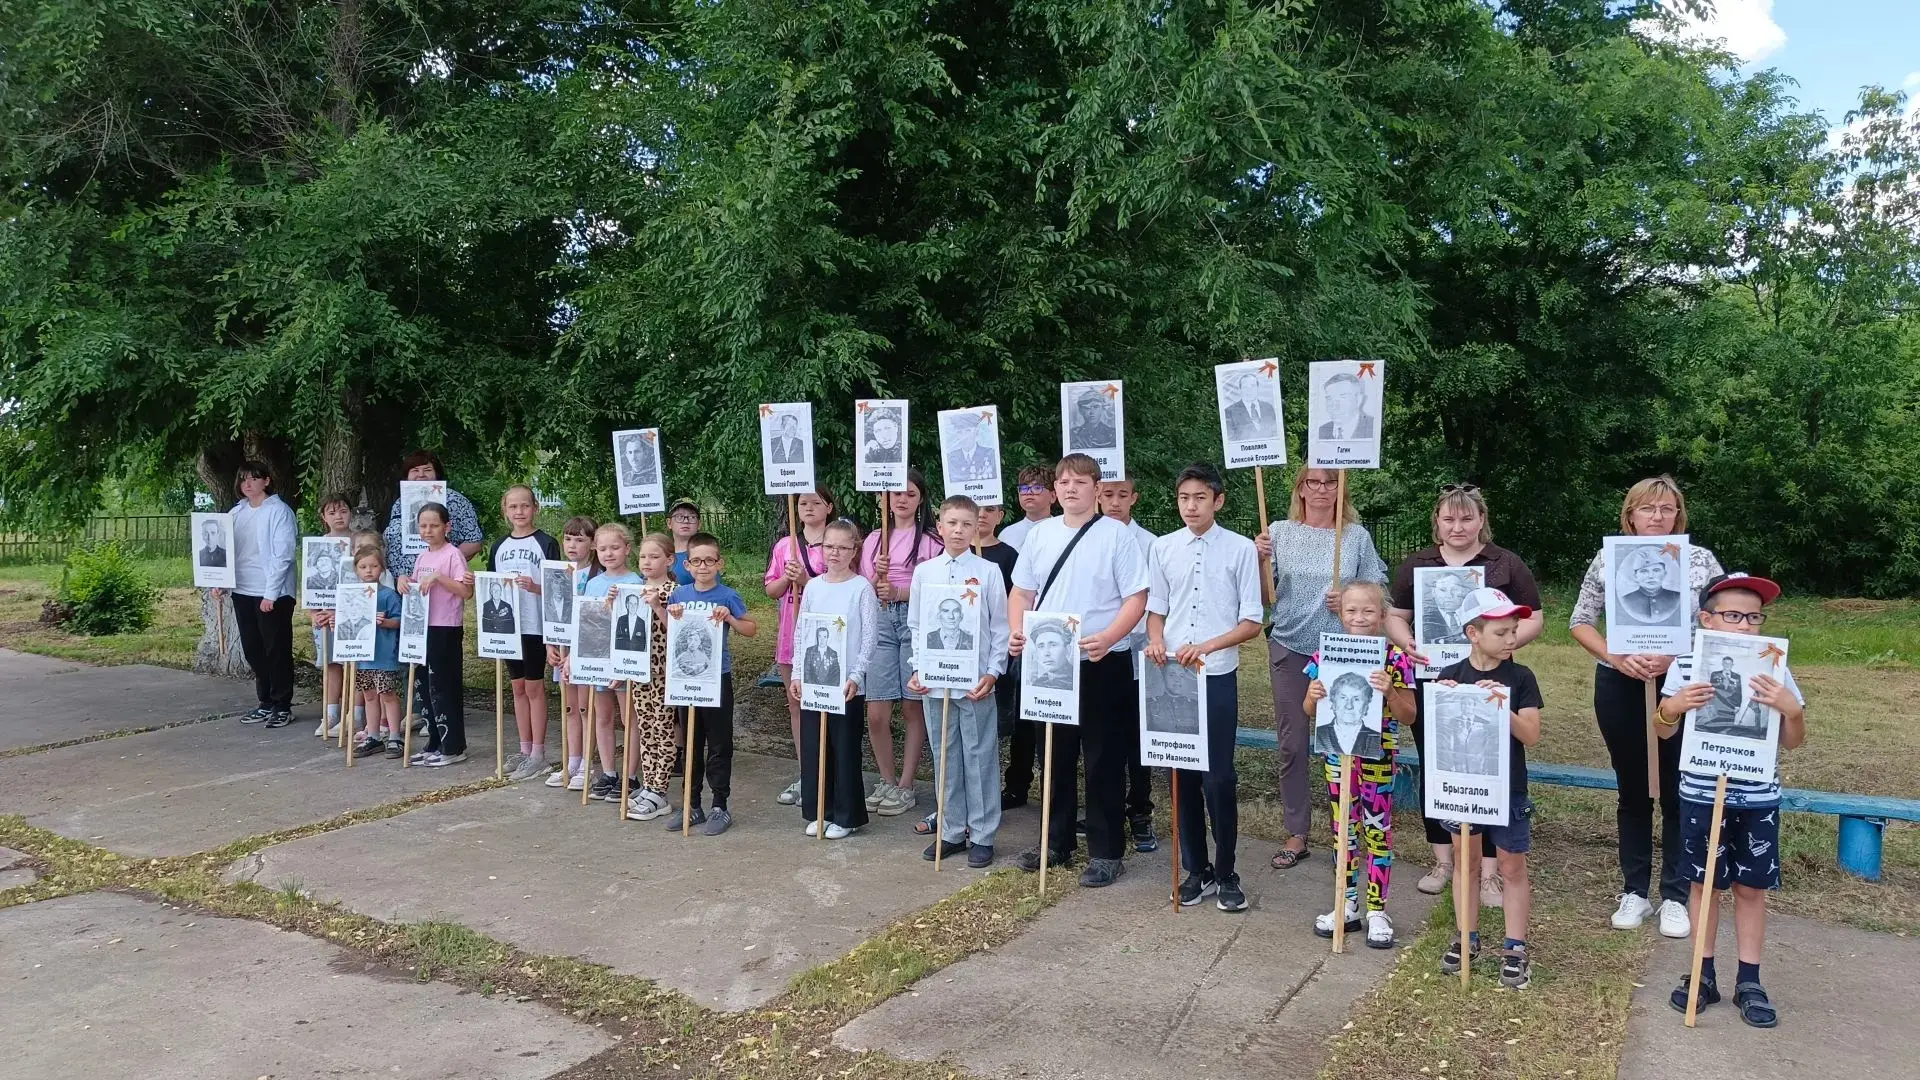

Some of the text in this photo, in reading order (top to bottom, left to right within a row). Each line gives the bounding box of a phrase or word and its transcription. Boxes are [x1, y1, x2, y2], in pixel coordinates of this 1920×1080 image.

[1240, 443, 1268, 451] Поваляев
[1230, 453, 1280, 464] Алексей Егорович
[787, 480, 810, 488] Гаврилович
[862, 480, 903, 488] Василий Ефимович
[518, 548, 541, 568] TEAM
[1322, 634, 1379, 645] Тимошина
[1324, 644, 1380, 655] Екатерина
[1441, 650, 1459, 660] Грачёв
[1323, 654, 1381, 665] Андреевна
[938, 661, 960, 670] Макаров
[924, 673, 973, 683] Василий Борисович
[693, 695, 715, 703] Андреевич
[1034, 696, 1062, 707] Тимофеев
[803, 699, 841, 711] Иван Васильевич
[1024, 708, 1072, 721] Иван Самойлович
[1151, 738, 1196, 750] Митрофанов
[1701, 741, 1756, 757] Петрачков
[1147, 751, 1200, 764] Пётр Иванович
[1689, 756, 1764, 774] Адам Кузьмич
[1442, 781, 1489, 796] Брызгалов
[1433, 799, 1499, 816] Николай Ильич
